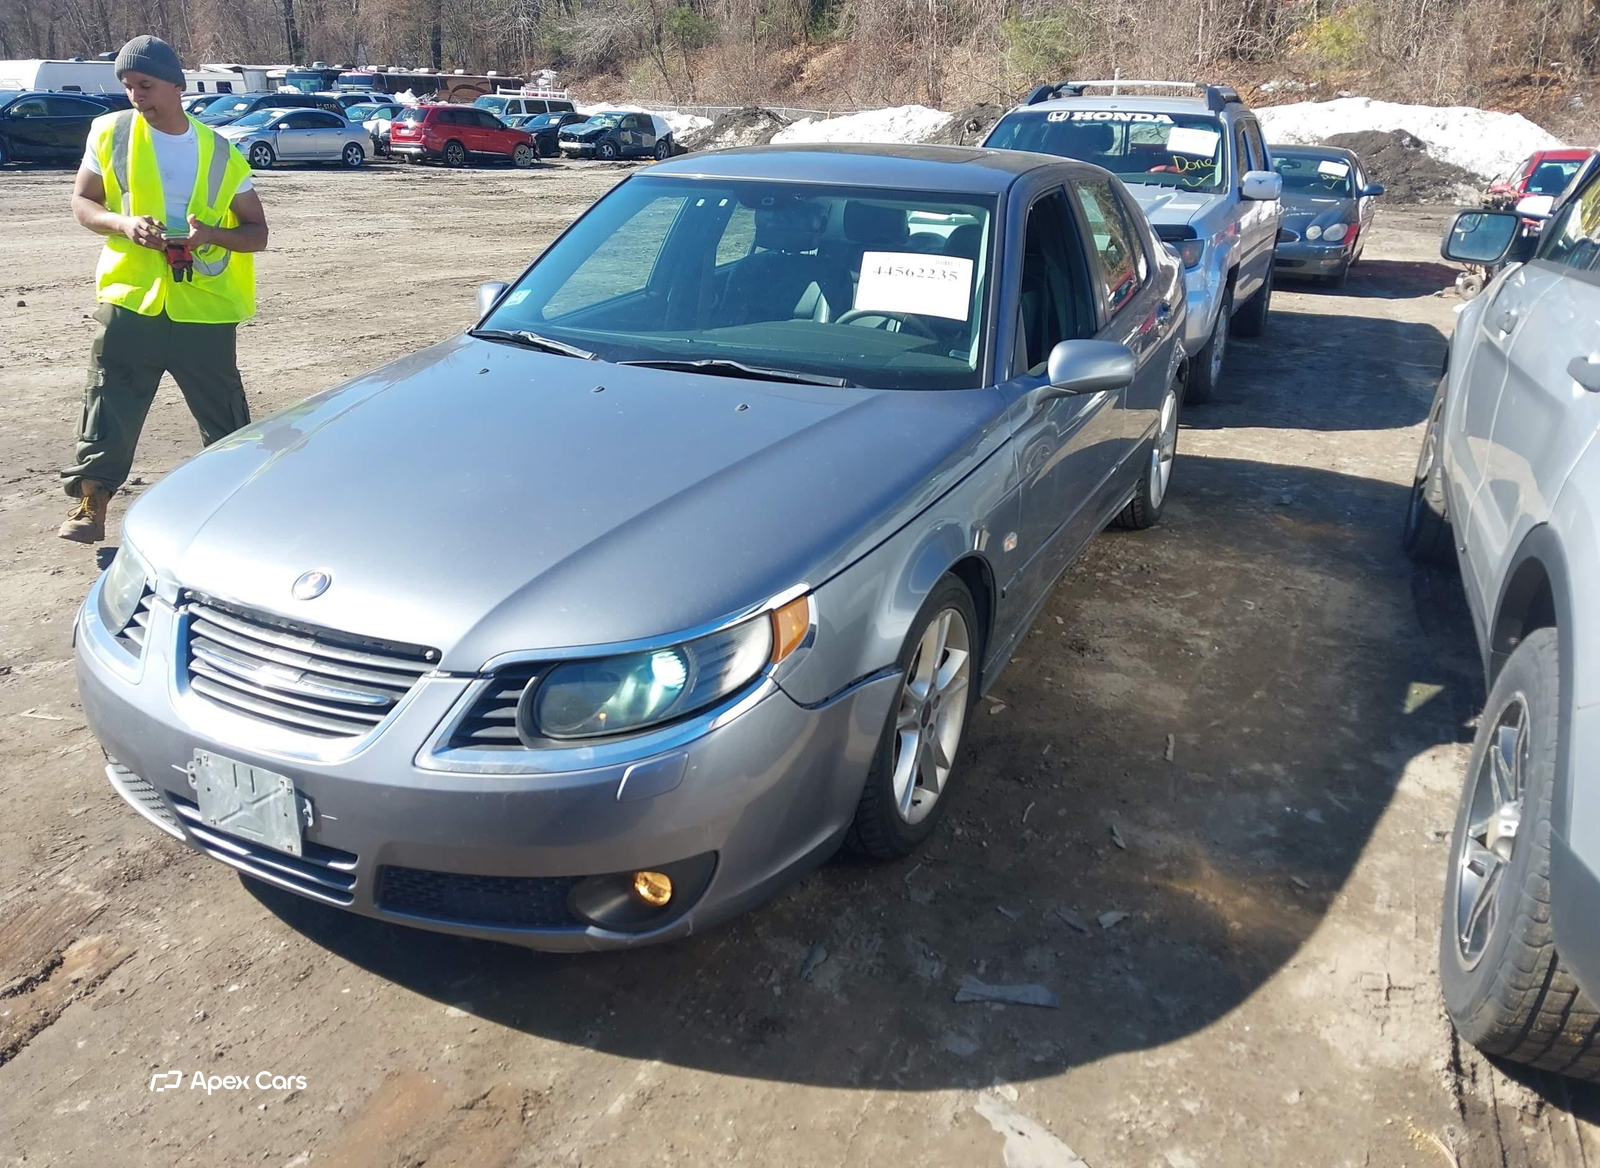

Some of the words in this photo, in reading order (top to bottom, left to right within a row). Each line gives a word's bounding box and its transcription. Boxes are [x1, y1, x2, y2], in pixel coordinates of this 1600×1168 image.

[1071, 111, 1175, 124] HONDA
[1172, 155, 1217, 173] Done
[872, 265, 959, 283] 44562235
